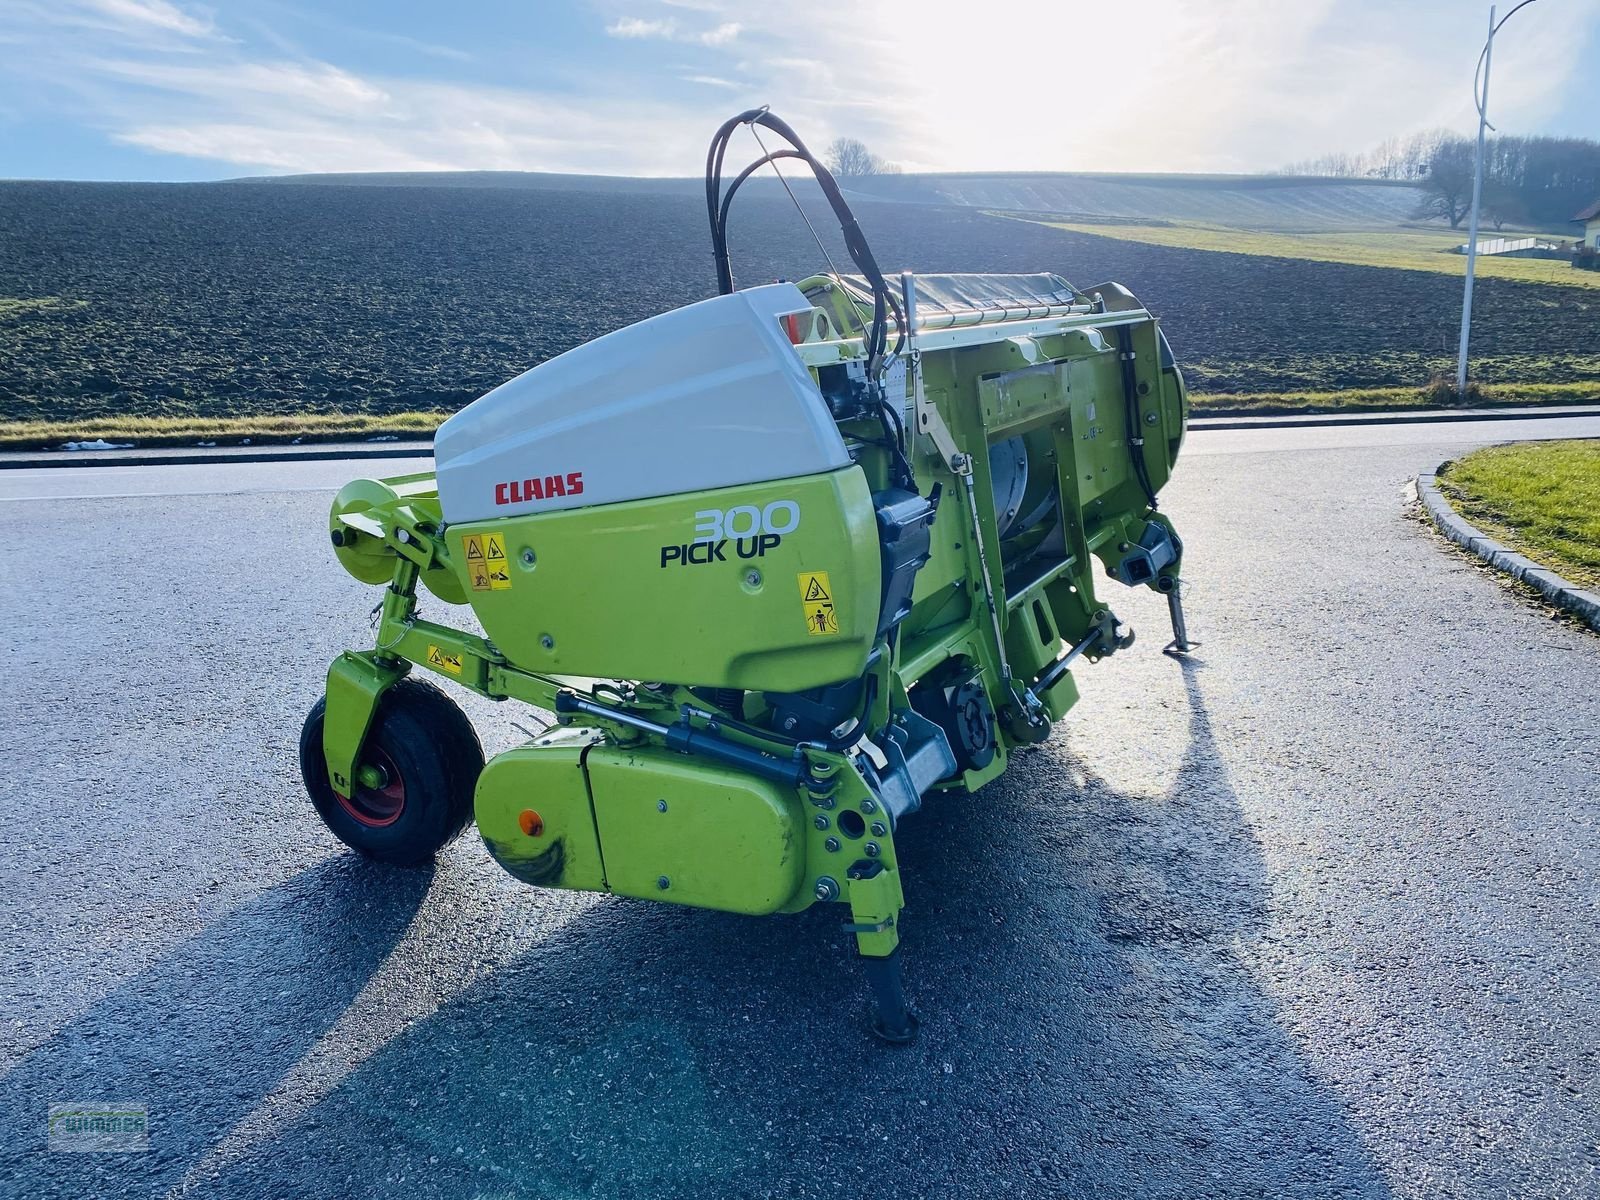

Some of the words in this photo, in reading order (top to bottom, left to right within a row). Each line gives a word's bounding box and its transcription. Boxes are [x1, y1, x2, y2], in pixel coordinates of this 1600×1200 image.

[495, 472, 583, 505] CLAAS
[694, 500, 800, 544] 300
[661, 540, 728, 568] PICK
[736, 534, 781, 559] UP
